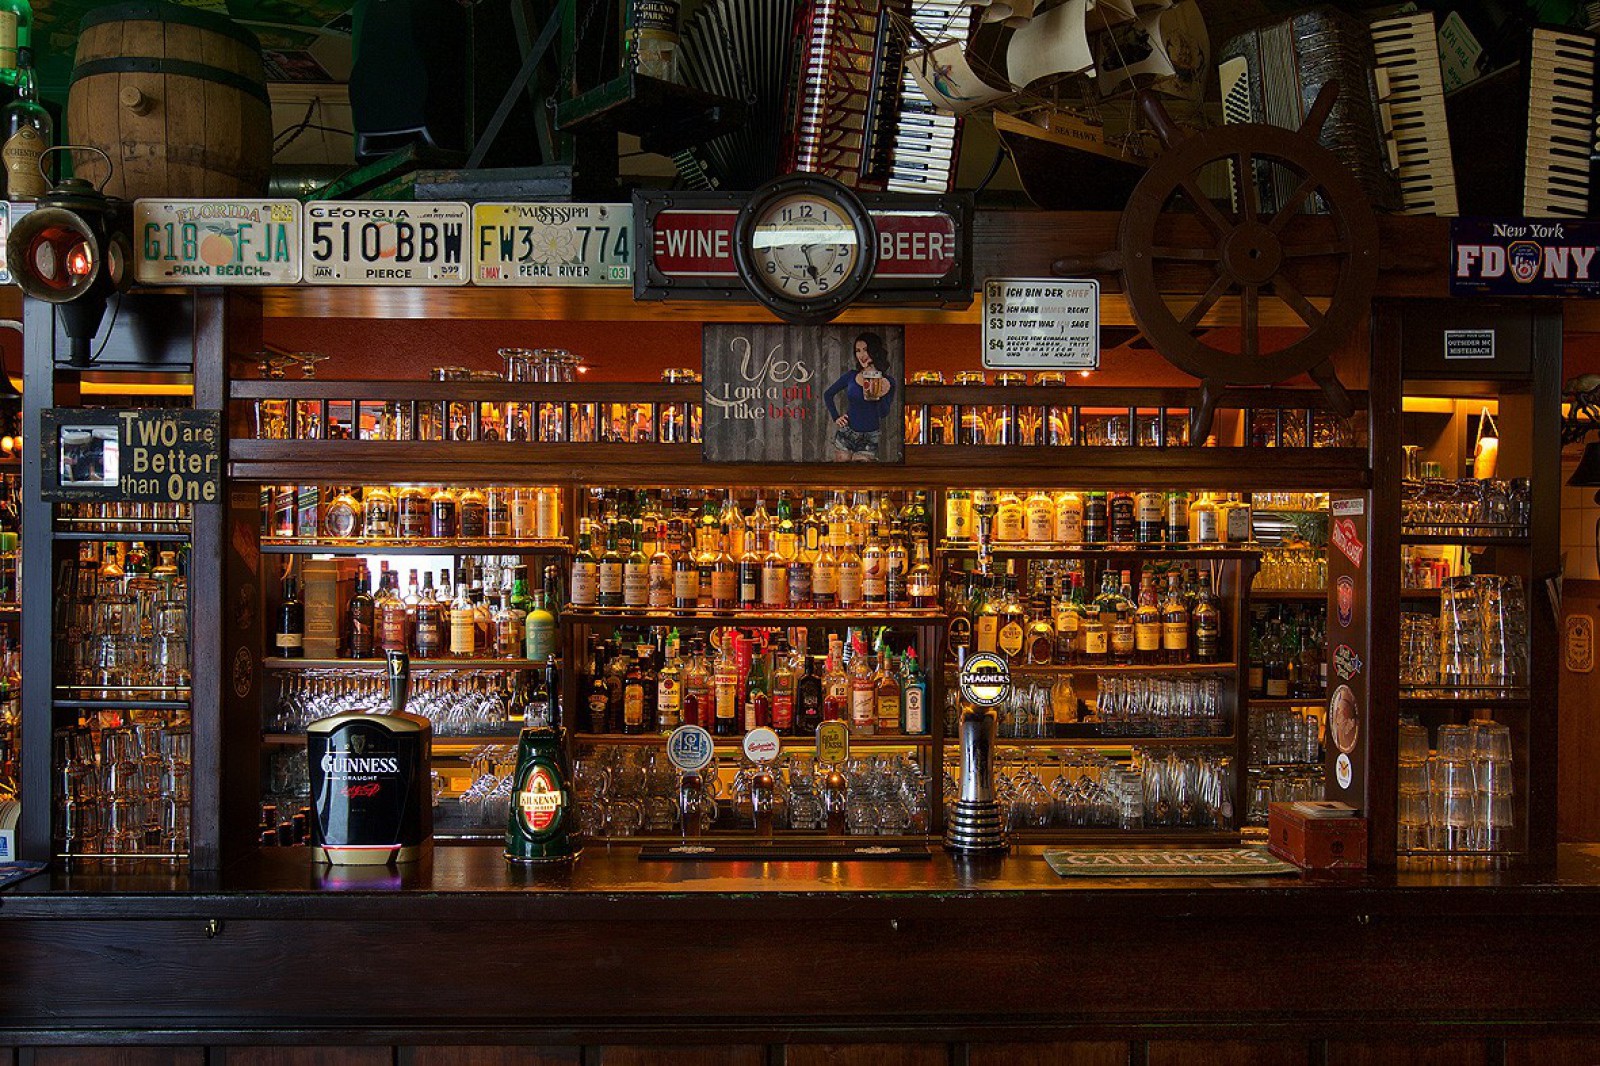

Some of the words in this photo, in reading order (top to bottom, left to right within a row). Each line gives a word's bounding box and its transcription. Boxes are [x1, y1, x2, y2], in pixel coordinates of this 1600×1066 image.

[633, 2, 674, 14] HGHLAND
[643, 11, 665, 20] PARK
[1072, 129, 1097, 143] HAWK
[176, 204, 261, 223] FLORIDA
[309, 207, 410, 219] GEORGIA
[445, 211, 464, 219] mind
[519, 205, 589, 226] MISSISSIPPI
[782, 209, 792, 221] 11
[800, 205, 813, 218] 12
[823, 210, 828, 222] 1
[1492, 223, 1527, 238] New
[1529, 222, 1564, 239] York
[145, 222, 198, 262] G18
[237, 223, 290, 263] FJA
[312, 221, 381, 262] 510
[395, 222, 463, 263] BBW
[480, 225, 535, 262] FW3
[576, 226, 630, 264] 774
[666, 229, 729, 258] WINE
[880, 232, 945, 261] BEER
[838, 244, 849, 257] 3
[766, 261, 776, 274] 8
[1457, 244, 1507, 278] FD
[1543, 246, 1596, 279] NY
[173, 265, 210, 276] PALM
[216, 265, 263, 276] BEACH
[314, 268, 332, 277] JAN
[366, 269, 412, 279] PIERCE
[485, 268, 500, 279] MAY
[519, 266, 552, 277] PEARL
[559, 266, 590, 277] RIVER
[612, 267, 625, 279] 03
[833, 263, 844, 275] 4
[780, 275, 790, 288] 7
[798, 281, 810, 294] 6
[819, 278, 829, 291] 5
[1006, 288, 1023, 298] ICH
[1025, 288, 1042, 298] BIN
[1045, 288, 1064, 298] DER
[1066, 289, 1090, 298] CHEF
[1067, 306, 1090, 314] RECHT
[1006, 320, 1017, 328] DU
[1019, 320, 1037, 328] TUST
[1039, 320, 1055, 328] WAS
[1071, 320, 1090, 329] SAGE
[730, 336, 815, 388] Yes
[724, 382, 730, 400] I
[734, 385, 762, 400] am
[766, 385, 779, 400] a
[733, 403, 765, 420] like
[183, 426, 214, 443] are
[133, 447, 216, 474] Better
[121, 474, 160, 495] than
[167, 473, 216, 501] One
[963, 674, 1010, 684] MAGNERS
[835, 687, 845, 695] 12
[321, 755, 399, 774] GUINNESS
[521, 794, 560, 805] KILKENNY
